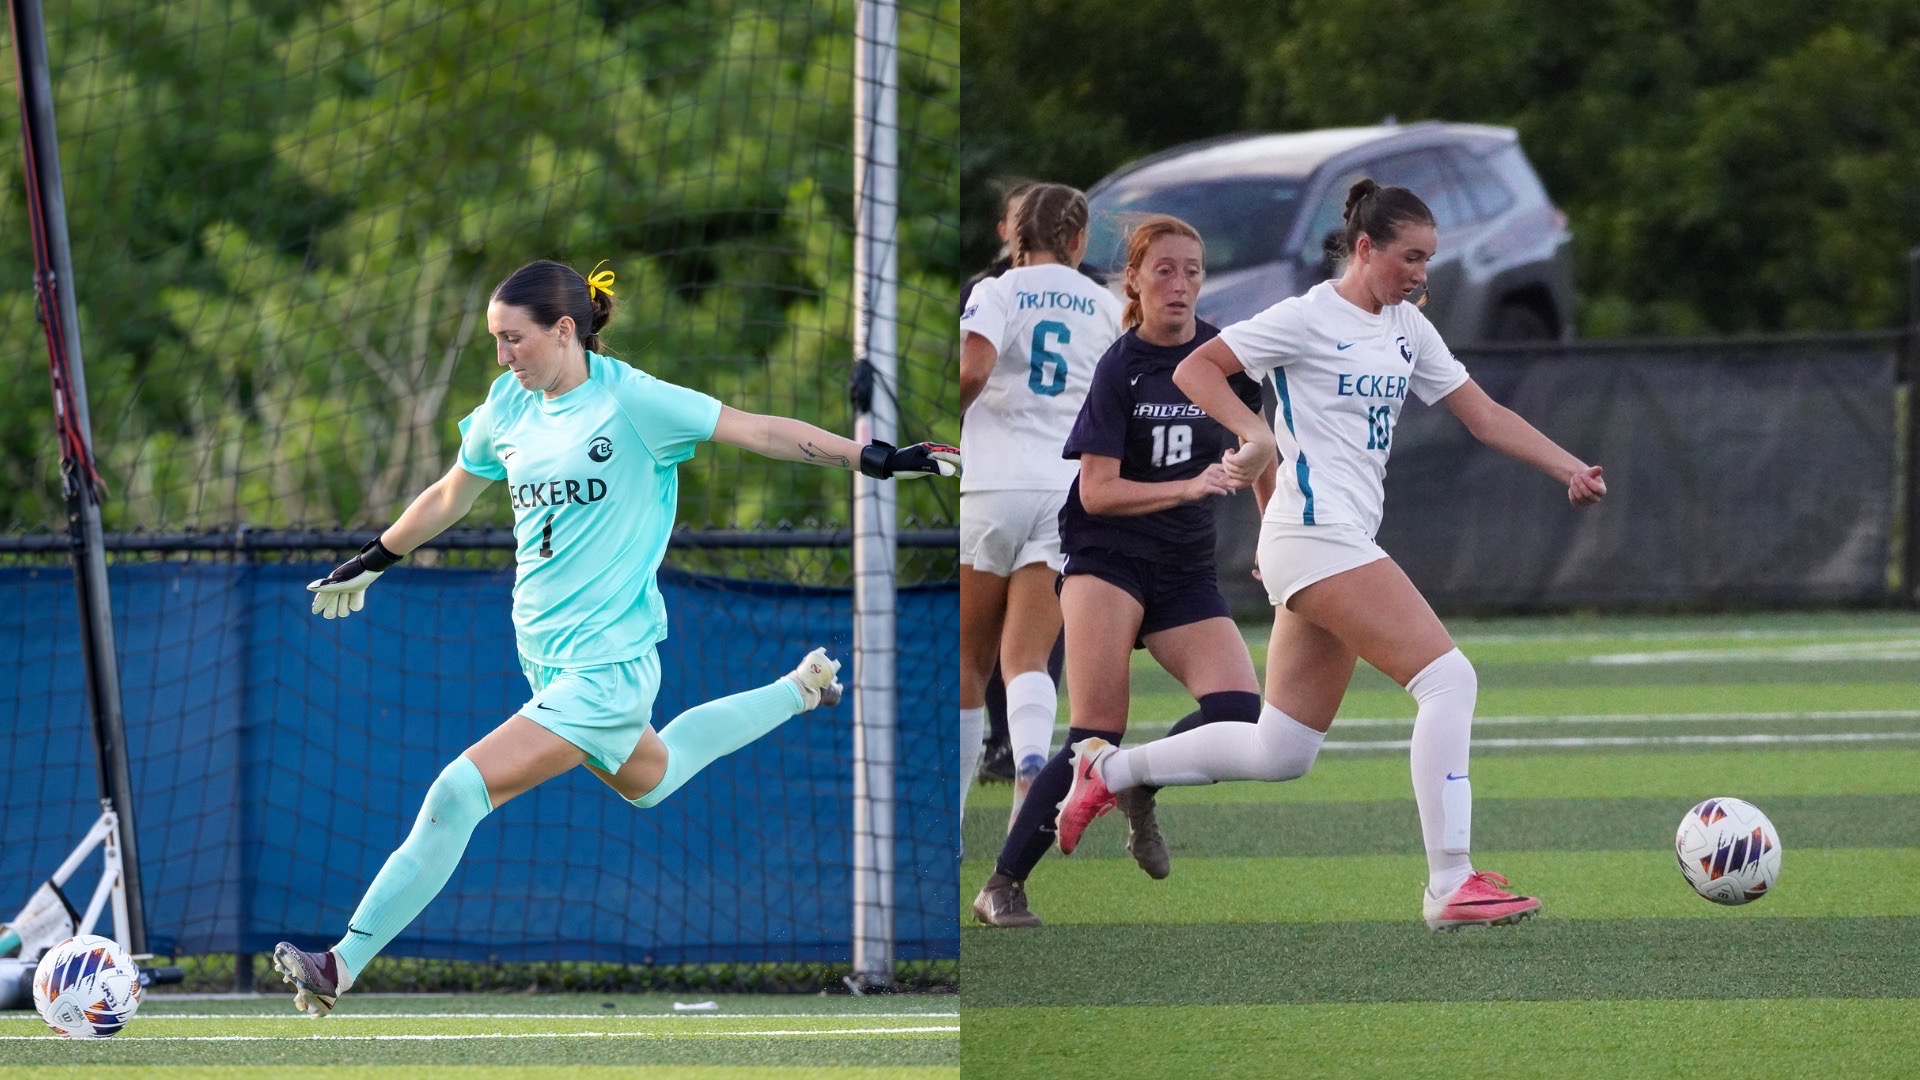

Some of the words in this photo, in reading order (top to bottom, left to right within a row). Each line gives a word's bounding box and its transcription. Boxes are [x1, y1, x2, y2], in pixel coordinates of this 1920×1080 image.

[1017, 291, 1097, 315] TRITONS
[1028, 319, 1071, 397] 6
[1337, 373, 1407, 400] ECKER
[1132, 403, 1208, 419] AILFIS
[1367, 405, 1390, 450] 10
[601, 442, 613, 453] EC
[1151, 425, 1193, 467] 18
[510, 478, 607, 508] ECKERD
[539, 513, 555, 558] 1
